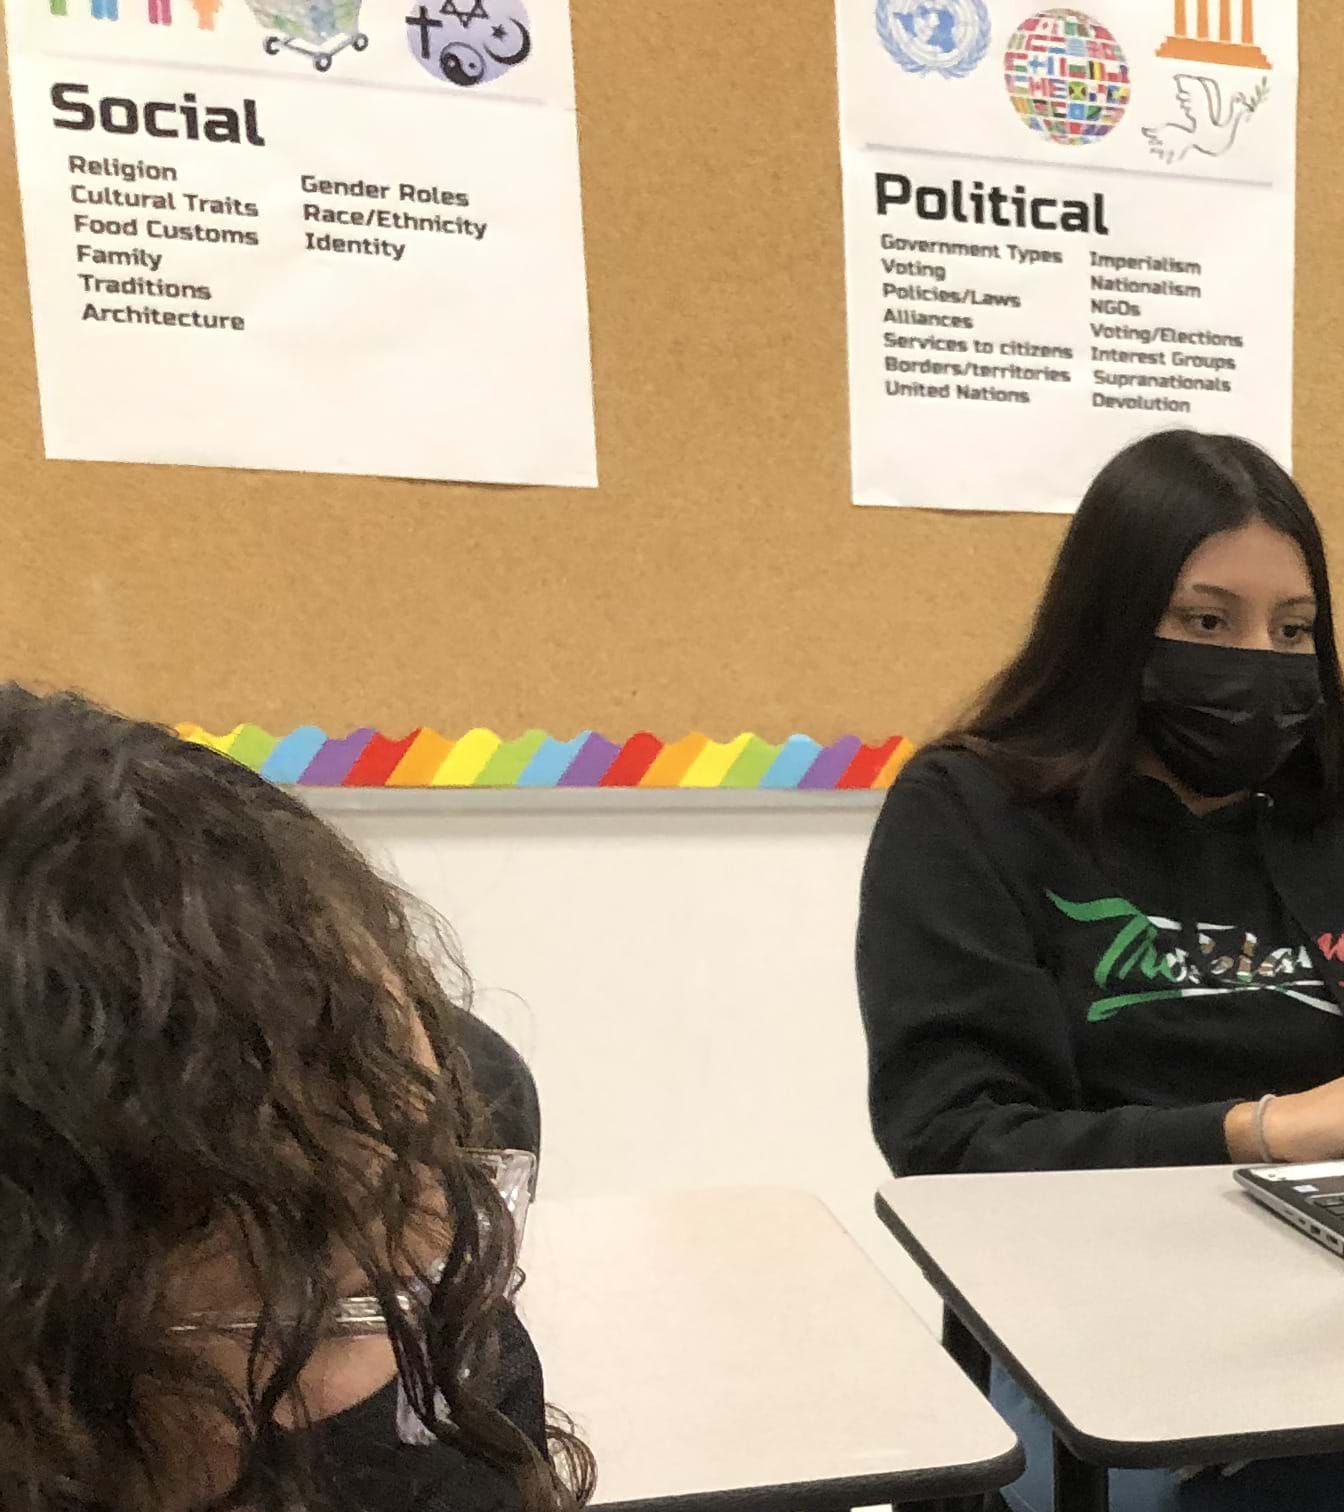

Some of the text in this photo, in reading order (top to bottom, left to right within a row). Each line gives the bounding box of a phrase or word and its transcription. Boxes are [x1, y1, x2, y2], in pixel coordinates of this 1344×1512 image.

[51, 83, 265, 146] Social
[69, 155, 177, 182] Religion
[71, 185, 259, 217] Cultural Traits
[301, 175, 469, 207] Gender Roles
[875, 172, 1108, 235] Political
[74, 214, 259, 245] Food Customs
[303, 204, 487, 240] Race/Ethnicity
[77, 244, 162, 271] Family
[305, 232, 405, 261] Identity
[881, 233, 1063, 264] Government Types
[881, 258, 946, 281] Voting
[1090, 251, 1201, 274] Imperialism
[78, 274, 212, 300] Traditions
[883, 283, 1021, 308] Policies/Laws
[1091, 275, 1201, 297] Nationalism
[82, 303, 244, 330] Architecture
[883, 308, 974, 329] Alliances
[1091, 299, 1141, 316] NGOs
[883, 332, 1073, 359] Services to citizens
[1090, 323, 1243, 347] Voting/Elections
[885, 356, 1071, 382] Borders/territories
[1091, 346, 1236, 371] Interest Groups
[885, 380, 1030, 403] United Nations
[1093, 369, 1231, 392] Supranationals
[1092, 392, 1190, 412] Devolution
